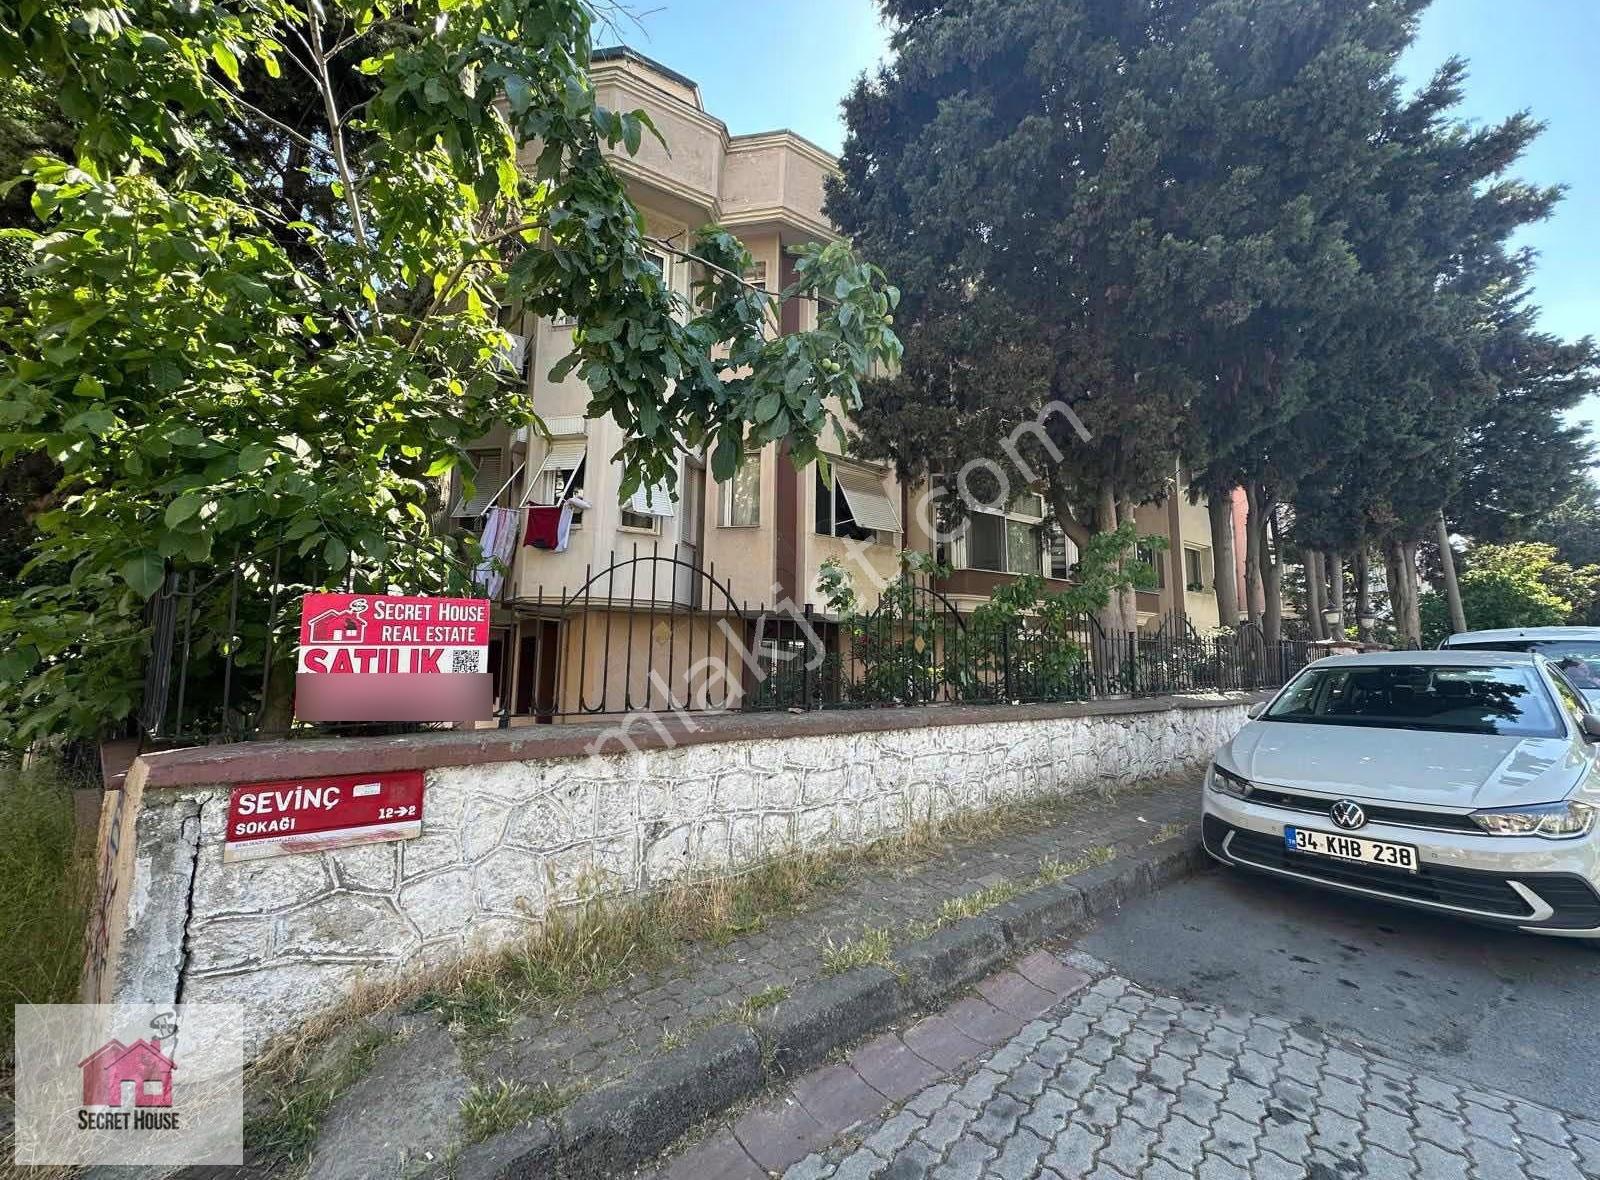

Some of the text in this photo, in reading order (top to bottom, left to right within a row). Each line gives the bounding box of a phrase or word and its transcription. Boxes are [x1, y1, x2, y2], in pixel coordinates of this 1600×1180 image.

[373, 600, 486, 622] SECRET HOUSE
[381, 625, 476, 643] REAL ESTATE
[238, 786, 341, 815] SEVİNÇ
[235, 817, 296, 836] SOKAĞI
[1296, 830, 1318, 850] 34
[1325, 835, 1362, 858] KHB
[1372, 843, 1412, 866] 238
